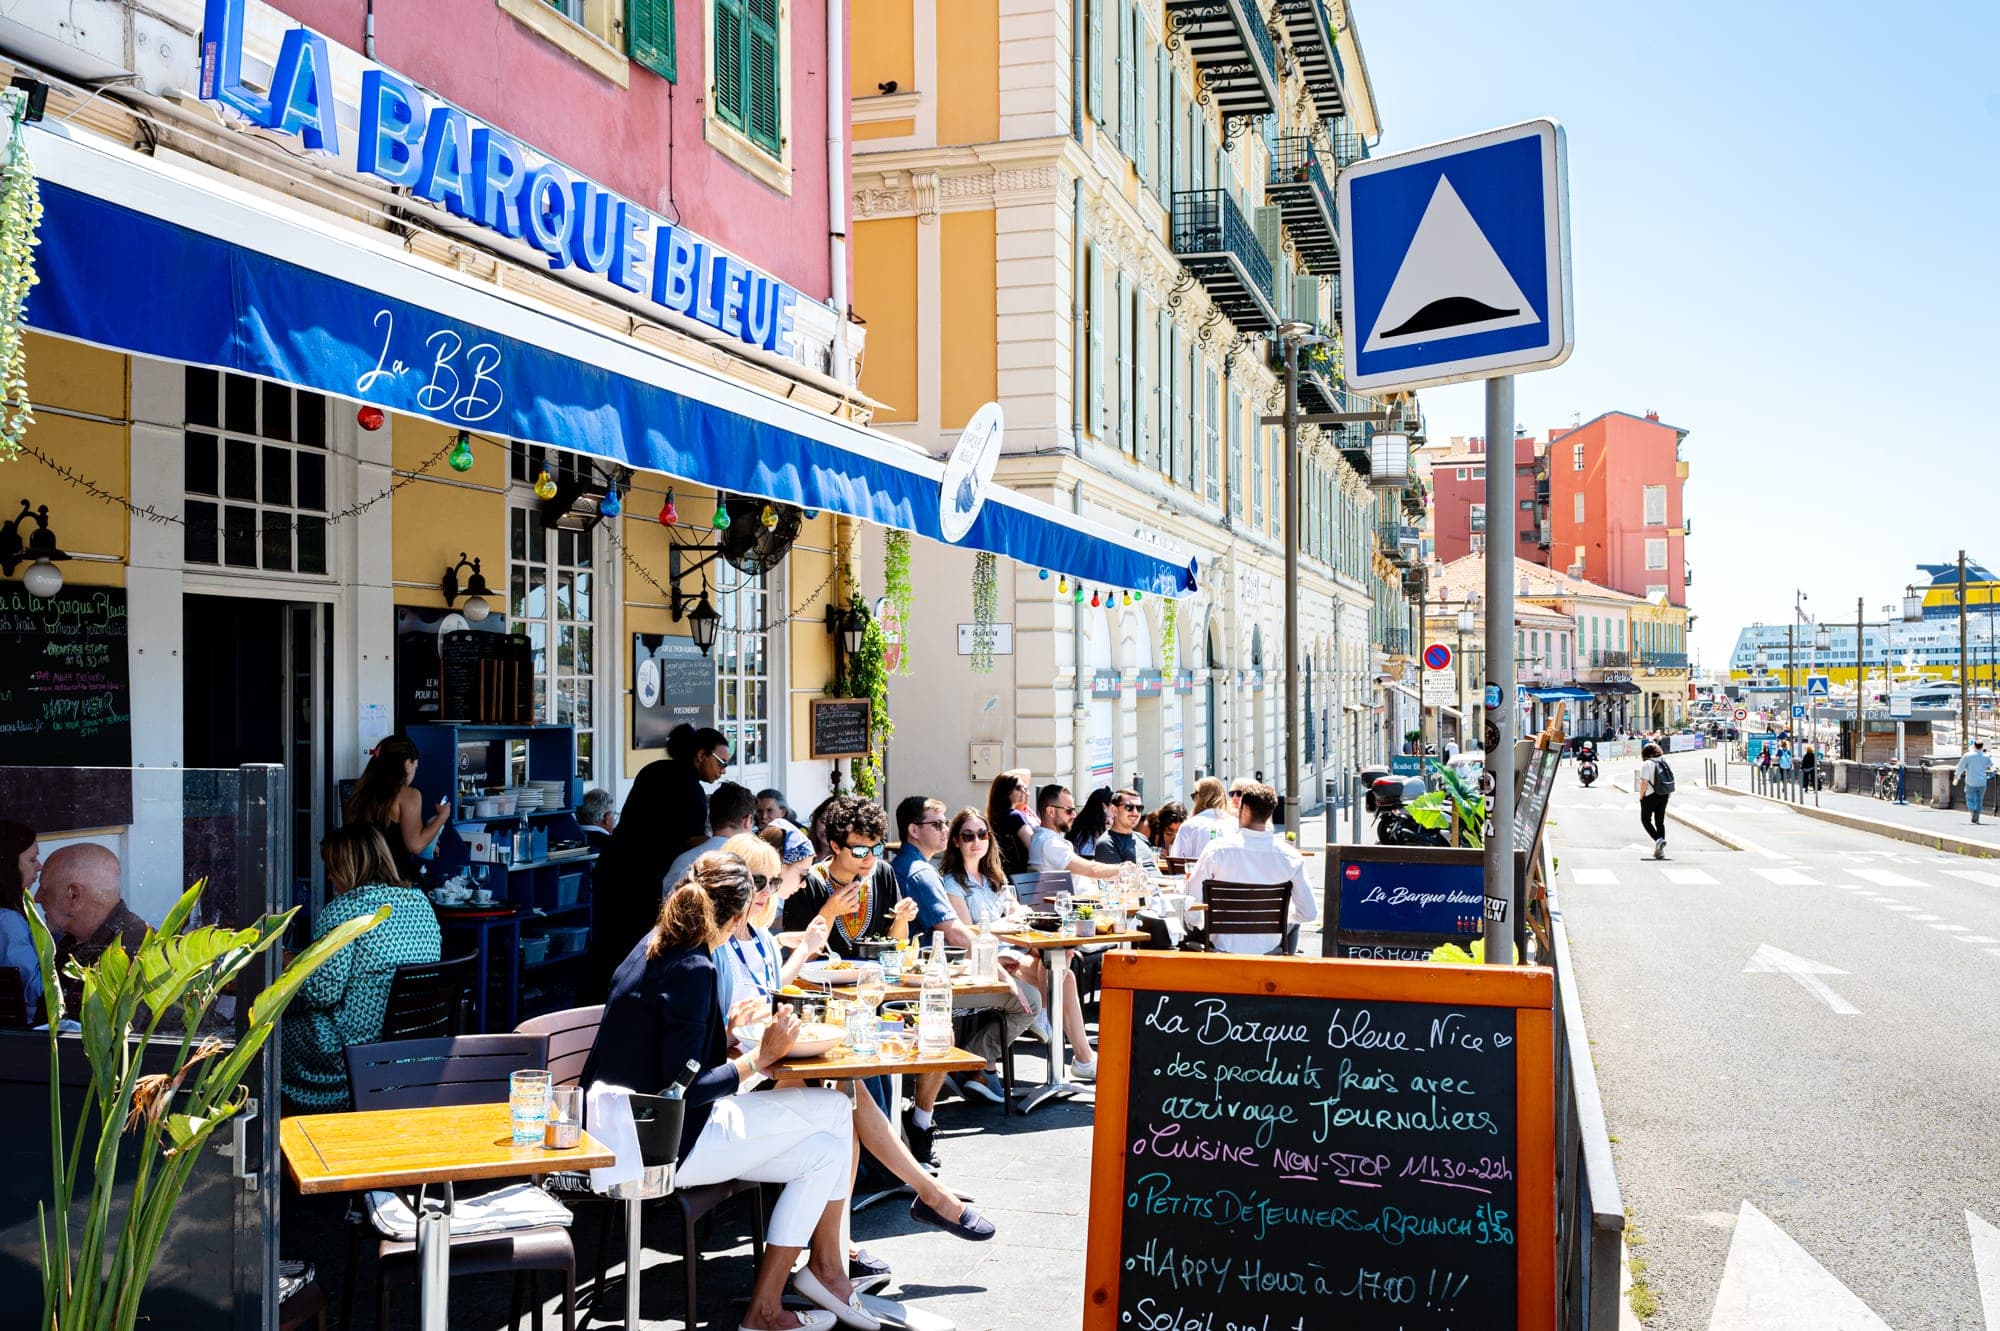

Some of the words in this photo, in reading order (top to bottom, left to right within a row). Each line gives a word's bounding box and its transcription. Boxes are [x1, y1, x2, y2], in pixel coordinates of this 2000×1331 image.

[202, 0, 340, 156] LA
[357, 70, 650, 294] BARQUE
[652, 225, 797, 357] BLEUE
[357, 309, 410, 394] La
[417, 329, 503, 421] BB
[1360, 886, 1387, 904] La
[1387, 886, 1446, 908] Barque
[1446, 889, 1484, 904] bleue
[1145, 995, 1190, 1033] La
[1194, 998, 1311, 1062] Barque
[1327, 1008, 1410, 1051] bleue
[1429, 1013, 1485, 1053] Nice
[1166, 1051, 1208, 1081] des
[1410, 1074, 1476, 1096] avec
[1161, 1096, 1299, 1148] arrivage
